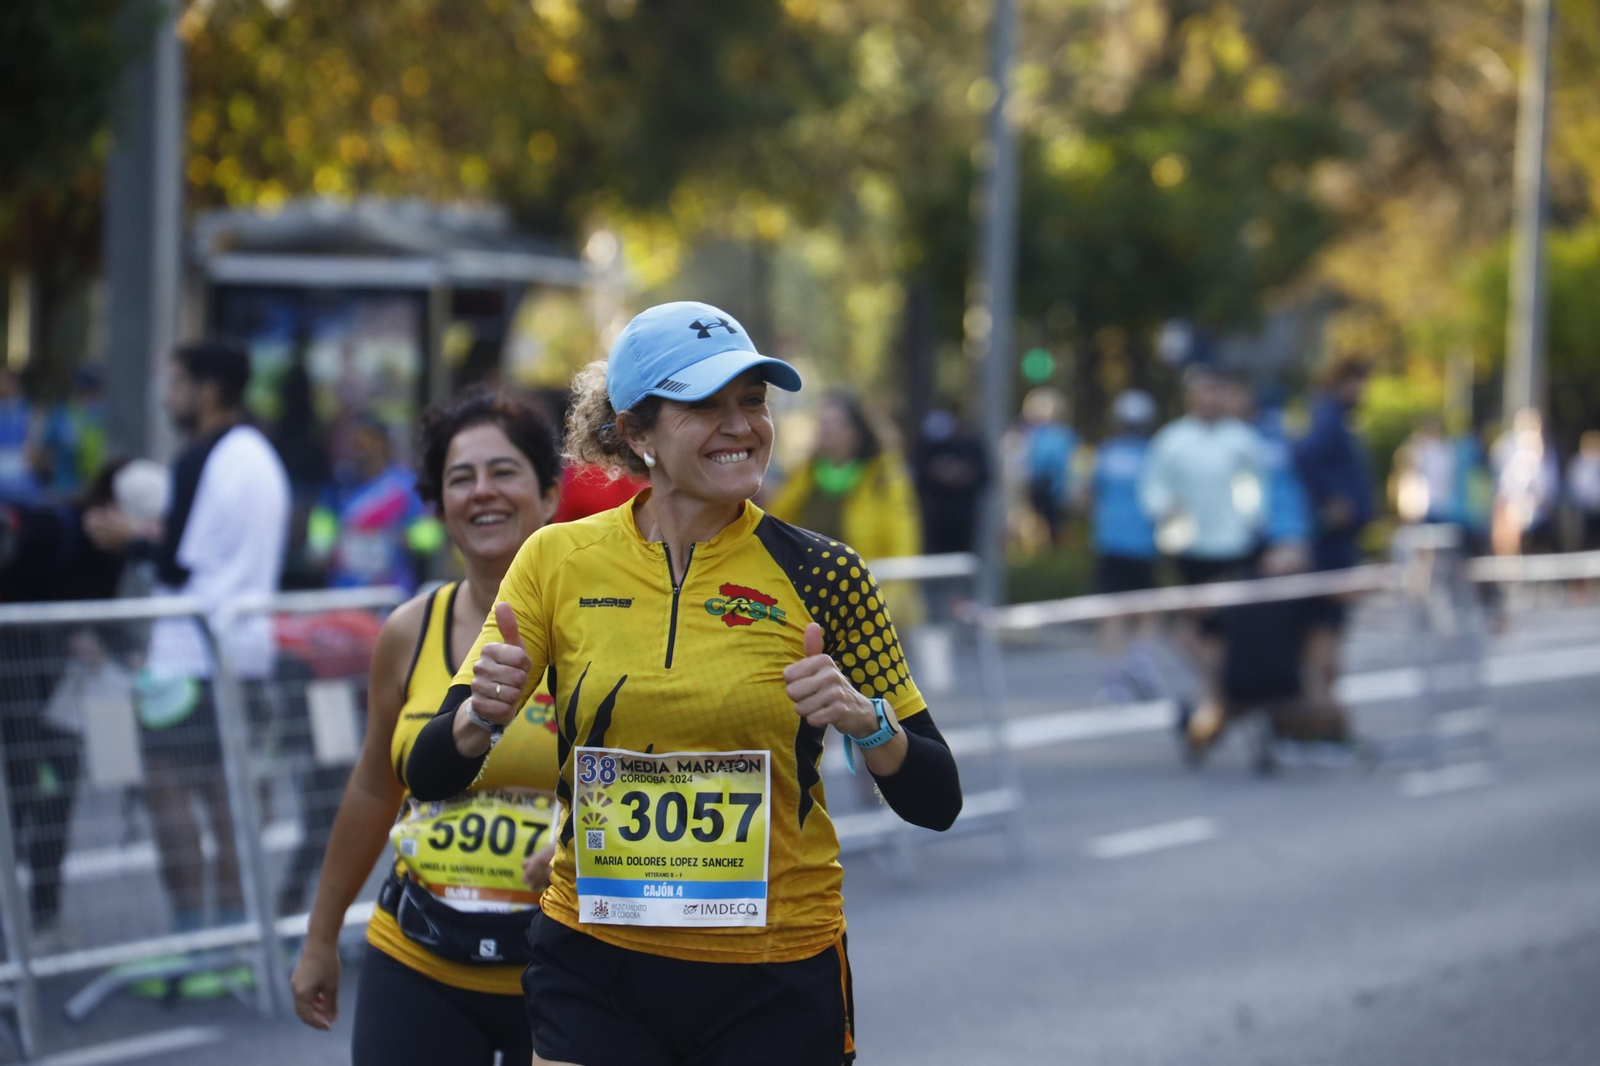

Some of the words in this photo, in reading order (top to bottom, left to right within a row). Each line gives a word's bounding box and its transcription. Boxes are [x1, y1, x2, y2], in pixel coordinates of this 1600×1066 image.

[579, 754, 617, 784] 38
[621, 758, 670, 774] MEDIA
[677, 755, 761, 774] MARATÓN
[670, 774, 693, 784] 2024
[618, 791, 762, 842] 3057
[428, 813, 549, 857] 5907
[594, 856, 623, 866] MARIA
[626, 856, 667, 867] DOLORES
[670, 857, 698, 867] LOPEZ
[702, 858, 744, 868] SANCHEZ
[643, 882, 674, 897] CAJÓN
[676, 885, 683, 897] 4
[700, 903, 757, 915] IMDECO
